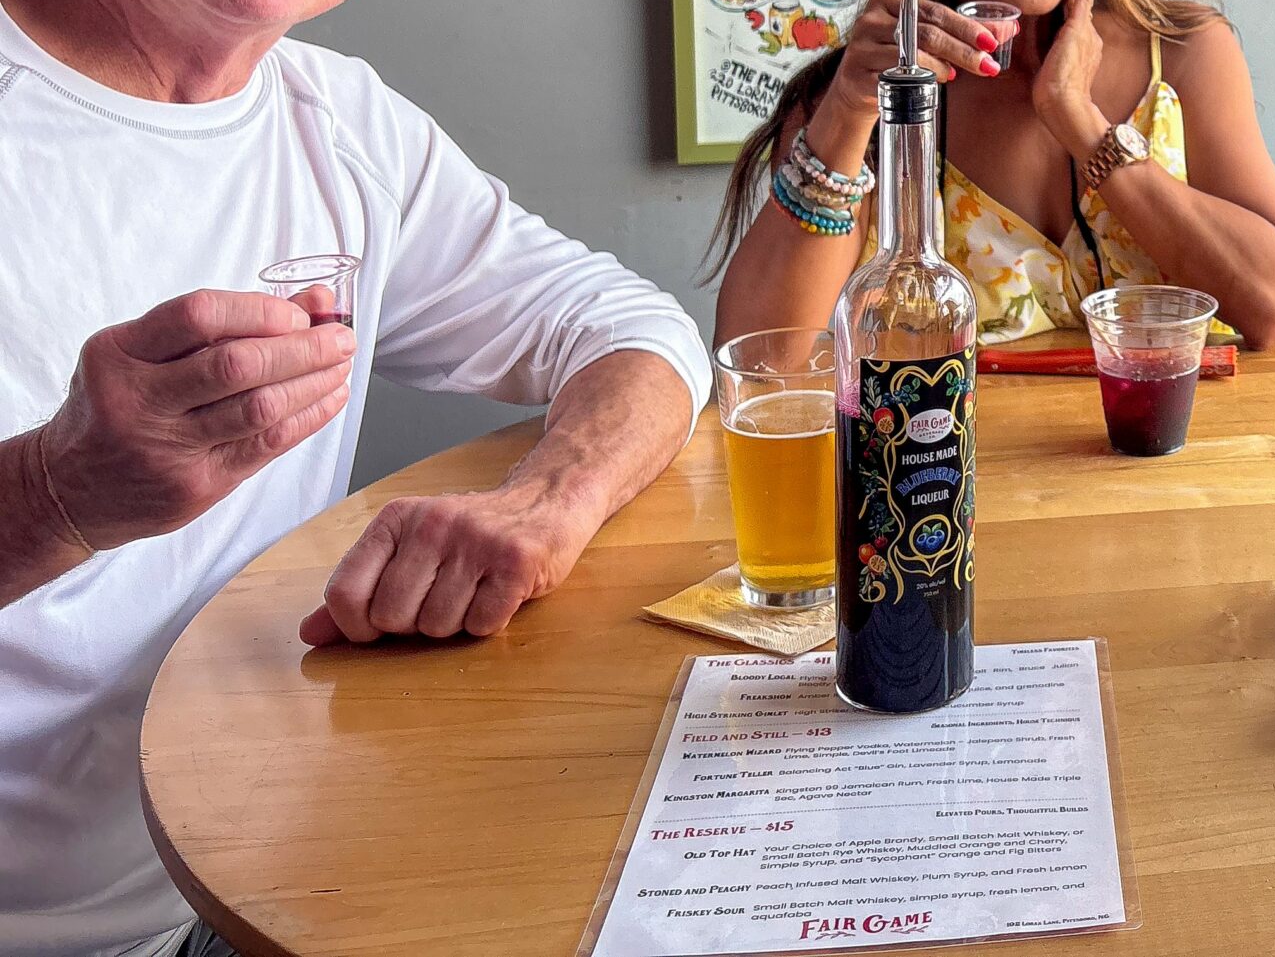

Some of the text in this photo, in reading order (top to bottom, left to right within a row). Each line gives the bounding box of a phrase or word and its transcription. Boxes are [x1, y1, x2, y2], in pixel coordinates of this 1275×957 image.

[911, 414, 951, 433] FAIR GAME
[901, 445, 958, 465] HOUSE MADE
[895, 466, 962, 496] BLUEBERRY
[911, 489, 950, 506] LIQUEUR
[707, 657, 831, 667] THE CLASSICS $11
[682, 728, 832, 743] FIELD AND STILL $13
[682, 748, 782, 760] WATERMELON WIZARD
[693, 767, 832, 782] FORTUNE TELLER Balancing
[663, 789, 770, 803] KINGSTON MARGARITA
[650, 820, 794, 841] THE RESERVE $15
[684, 850, 706, 860] OLD
[709, 849, 731, 858] TOP
[733, 848, 757, 857] HAT
[764, 844, 789, 853] Your
[791, 842, 832, 851] Choice
[852, 838, 882, 848] Apple
[884, 836, 926, 845] Brandy,
[928, 834, 960, 842] Small
[962, 832, 995, 840] Batch
[997, 831, 1020, 839] Malt
[1023, 829, 1070, 838] Whiskey,
[761, 852, 794, 861] Small
[796, 850, 829, 859] Batch
[832, 848, 854, 857] Rye
[856, 845, 904, 855] Whiskey,
[907, 843, 957, 852] Muddled
[959, 841, 1001, 850] Orange
[1028, 837, 1068, 846] Cherry,
[759, 861, 800, 870] Simple
[802, 858, 837, 867] Syrup,
[840, 856, 863, 864] and
[938, 850, 980, 860] Orange
[1008, 847, 1025, 856] Fig
[1027, 845, 1062, 854] Bitters
[637, 887, 682, 898] STONED
[684, 886, 707, 896] AND
[709, 885, 751, 894] PEACHY
[796, 879, 839, 889] Infused
[841, 876, 867, 885] Malt
[869, 874, 919, 884] Whiskey,
[922, 872, 951, 881] Plum
[953, 870, 988, 880] Syrup,
[991, 868, 1014, 876] and
[1016, 866, 1047, 874] Fresh
[1049, 864, 1088, 872] Lemon
[666, 882, 1085, 918] FRISKEY SOUR Small Batch Malt Whiskey, simple syrup, fresh lemon, and
[750, 910, 812, 922] aquafaba
[799, 911, 933, 940] FAIR GAME
